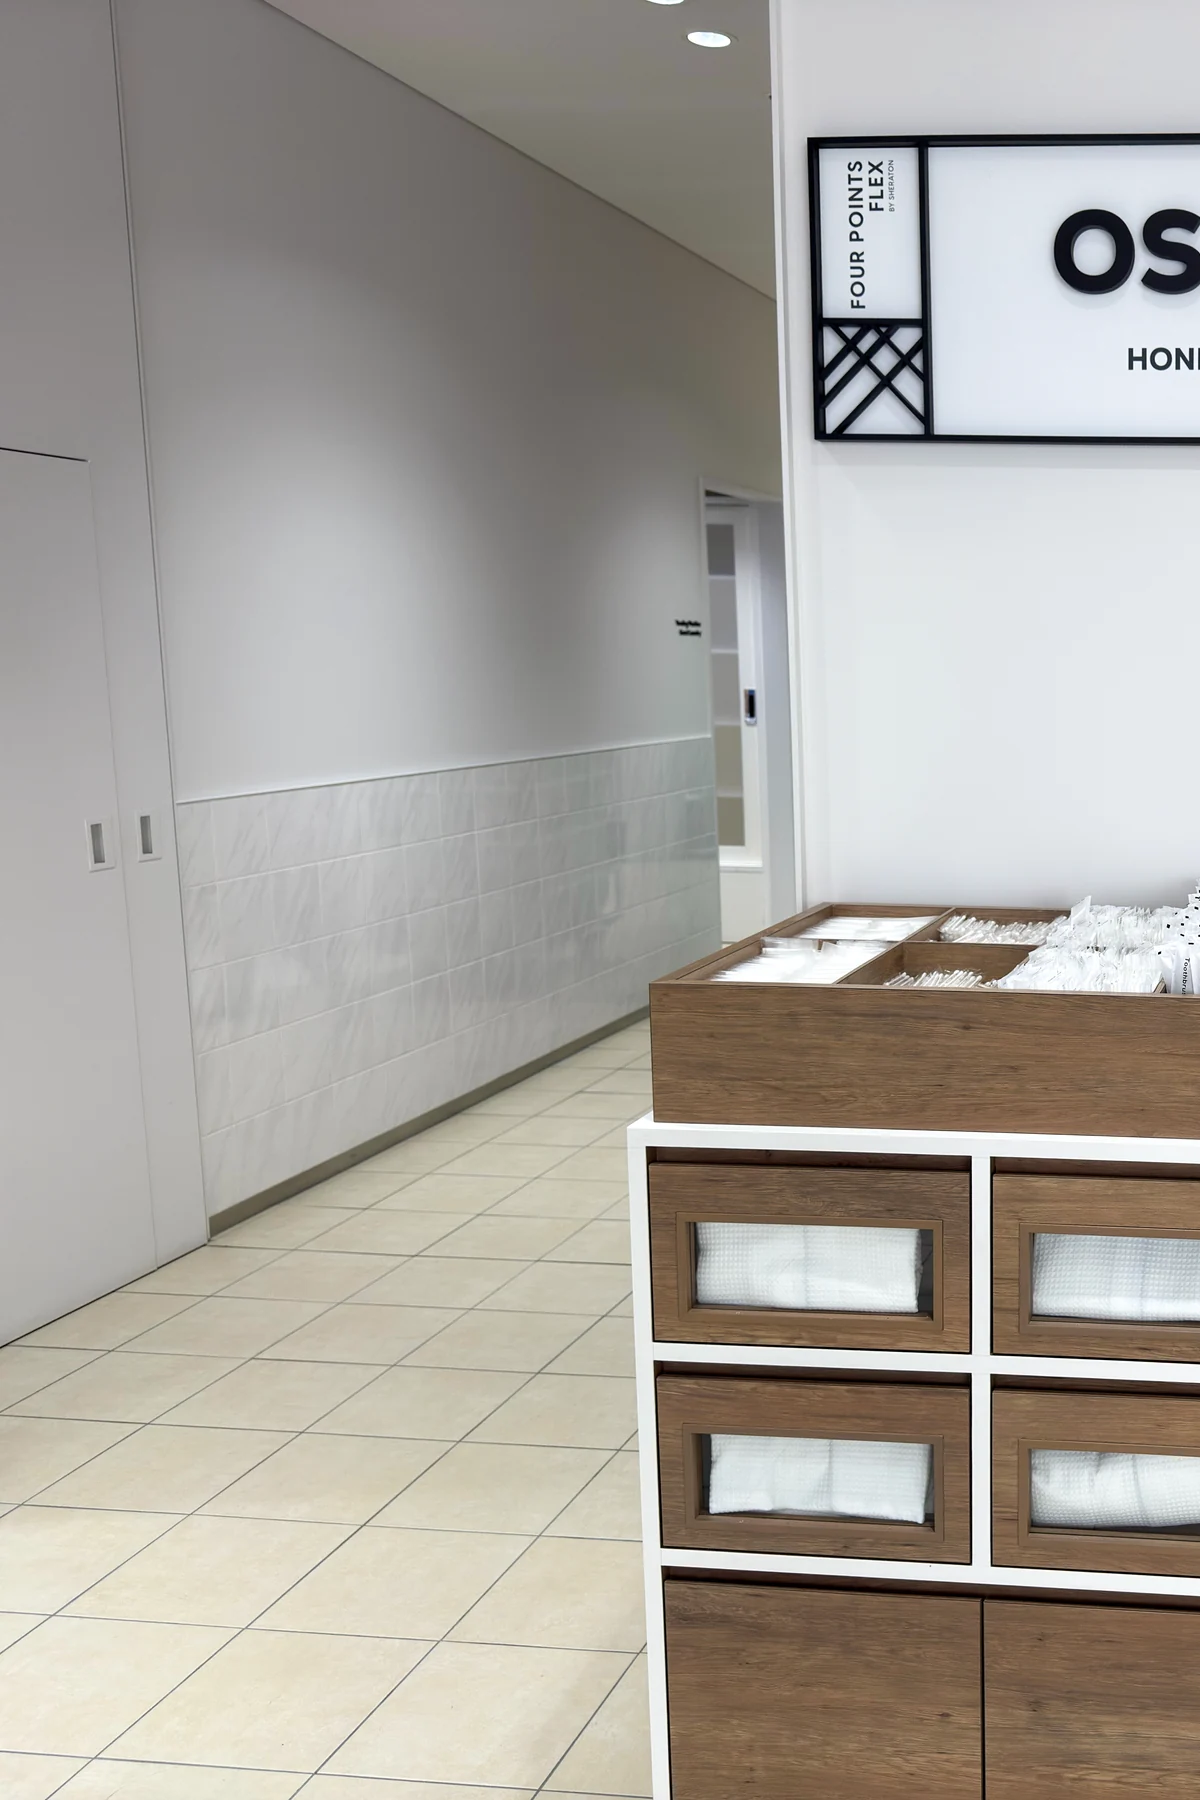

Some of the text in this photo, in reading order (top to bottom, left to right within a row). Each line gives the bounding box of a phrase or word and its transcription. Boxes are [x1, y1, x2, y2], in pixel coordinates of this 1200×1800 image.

[868, 160, 884, 212] FLEX
[889, 202, 895, 212] BY
[848, 160, 865, 309] FOUR POINTS
